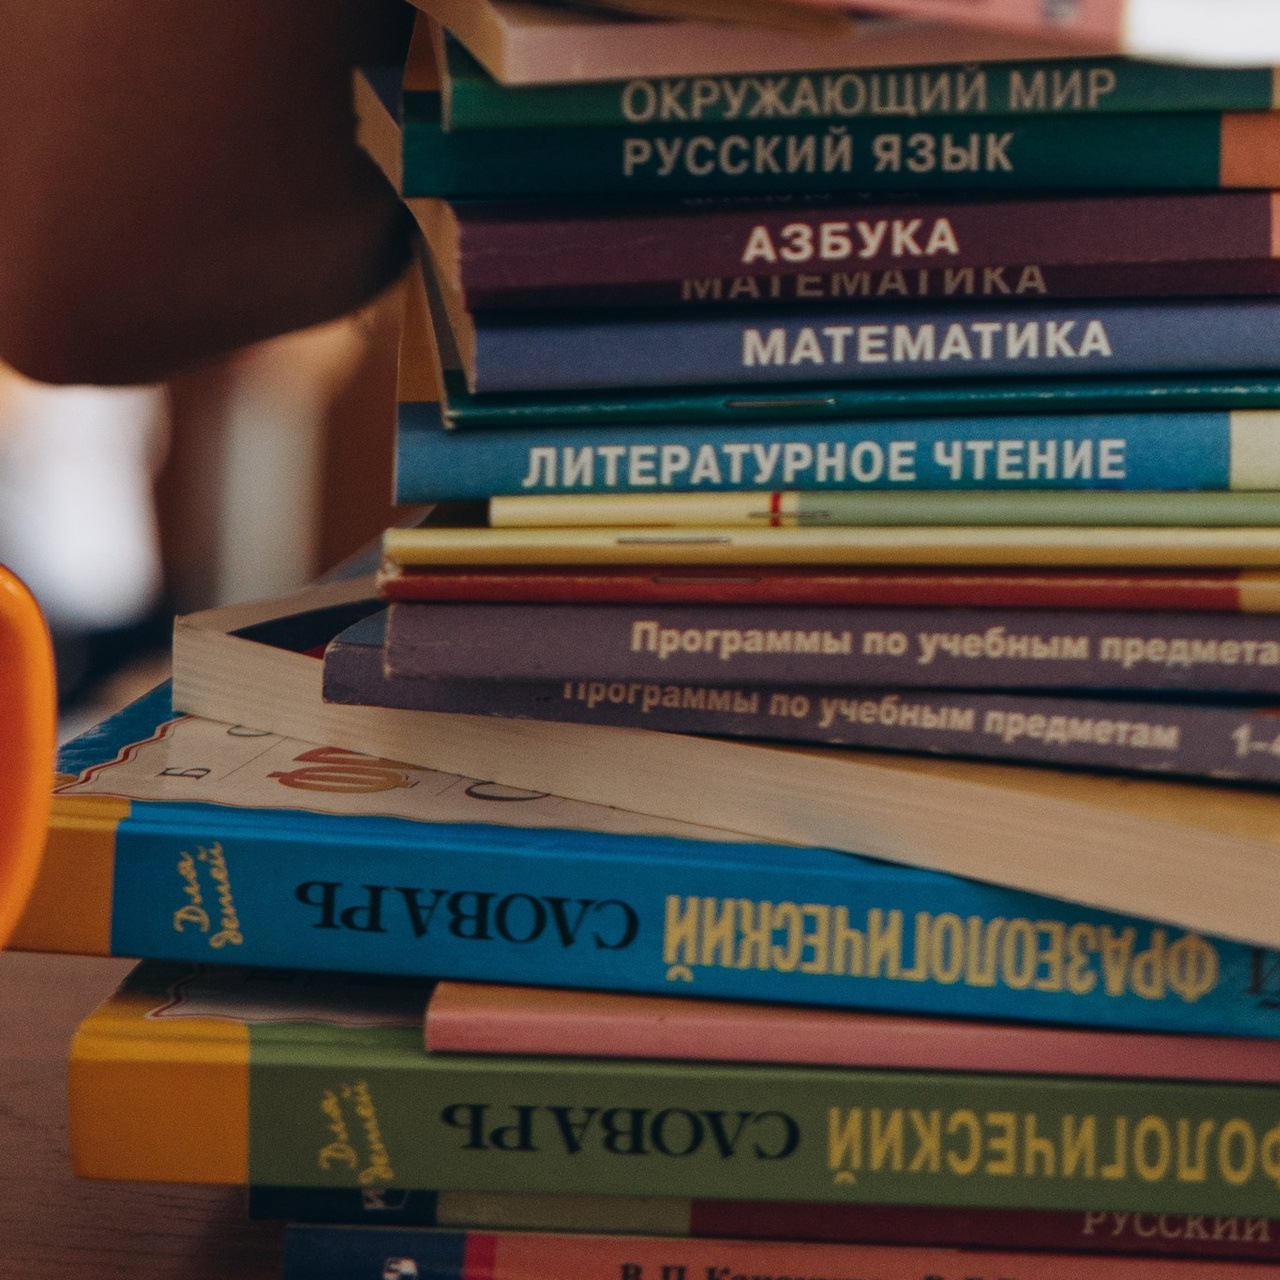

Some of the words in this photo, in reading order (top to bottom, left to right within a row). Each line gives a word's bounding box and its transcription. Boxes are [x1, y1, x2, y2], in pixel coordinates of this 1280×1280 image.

[621, 64, 988, 122] ОКРУЖАЮЩИЙ
[1006, 67, 1118, 114] МИР
[621, 128, 854, 177] РУССКИЙ
[871, 131, 1015, 173] ЯЗЫК
[740, 218, 960, 264] АЗБУКА
[742, 320, 1112, 368] МАТЕМАТИКА
[522, 442, 918, 489] ЛИТЕРАТУРНОЕ
[933, 438, 1128, 482] ЧТЕНИЕ
[631, 619, 854, 659] Программы
[861, 628, 909, 657] по
[917, 626, 1091, 667] учебным
[562, 679, 761, 718] Программы
[767, 690, 809, 720] по
[817, 696, 976, 736] учебным
[984, 710, 1180, 752] предметам
[295, 879, 640, 951] СЛОВАРЬ
[662, 892, 1218, 1002] ФРАЗЕОЛОГИЧЕСКИЙ
[440, 1101, 801, 1164] СЛОВАРЬ
